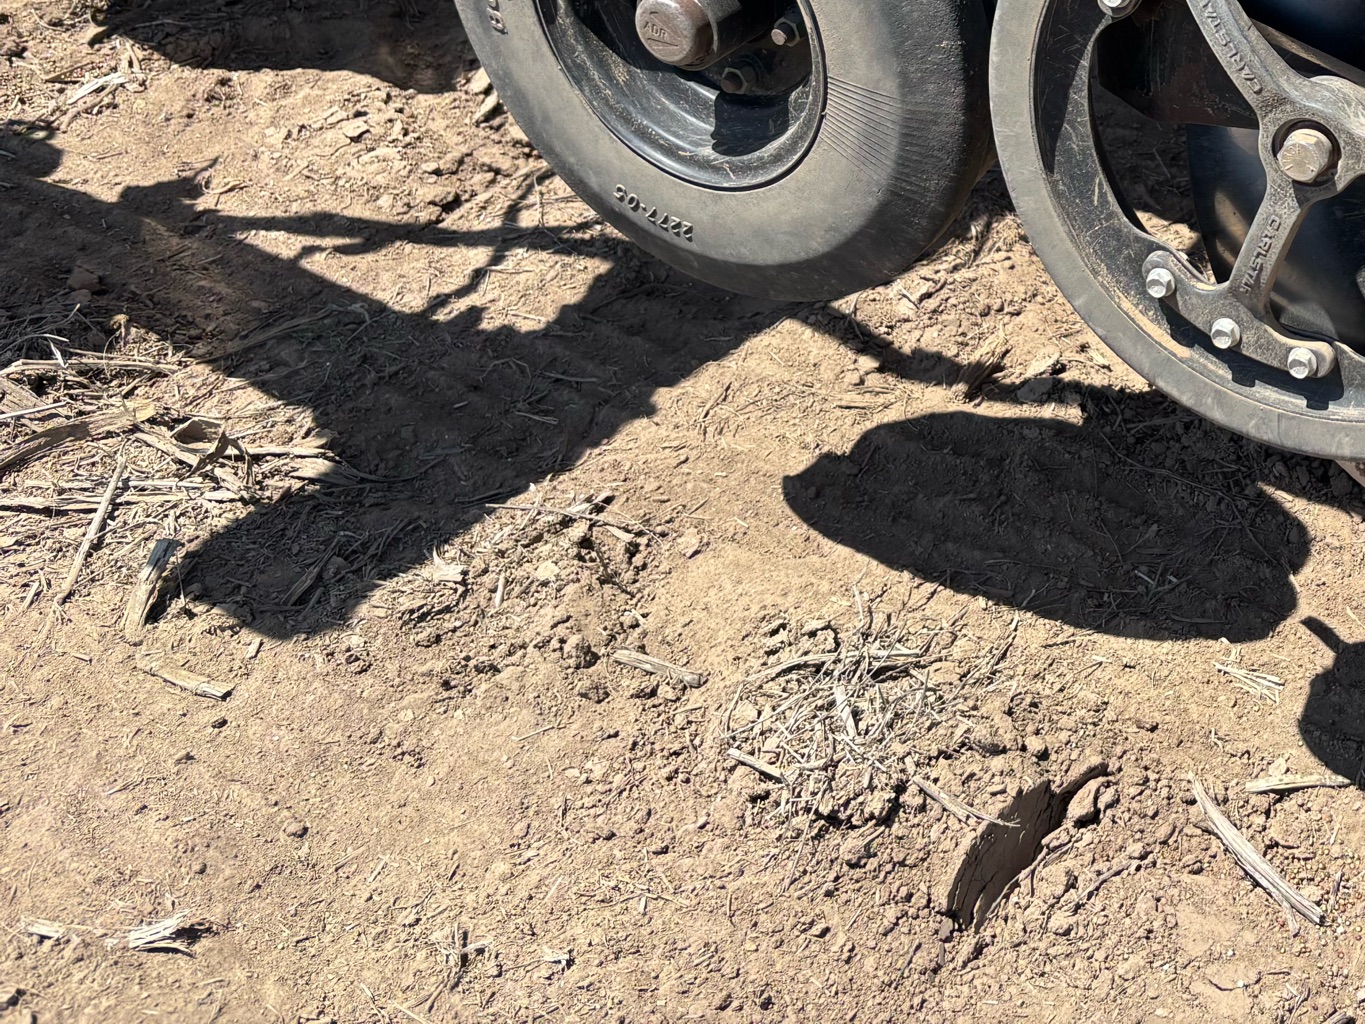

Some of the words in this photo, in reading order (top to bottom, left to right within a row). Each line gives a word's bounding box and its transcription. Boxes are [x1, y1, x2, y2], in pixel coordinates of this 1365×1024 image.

[644, 21, 668, 39] ADR
[613, 184, 693, 243] 2277-05
[1240, 215, 1281, 294] CARLSTAR
